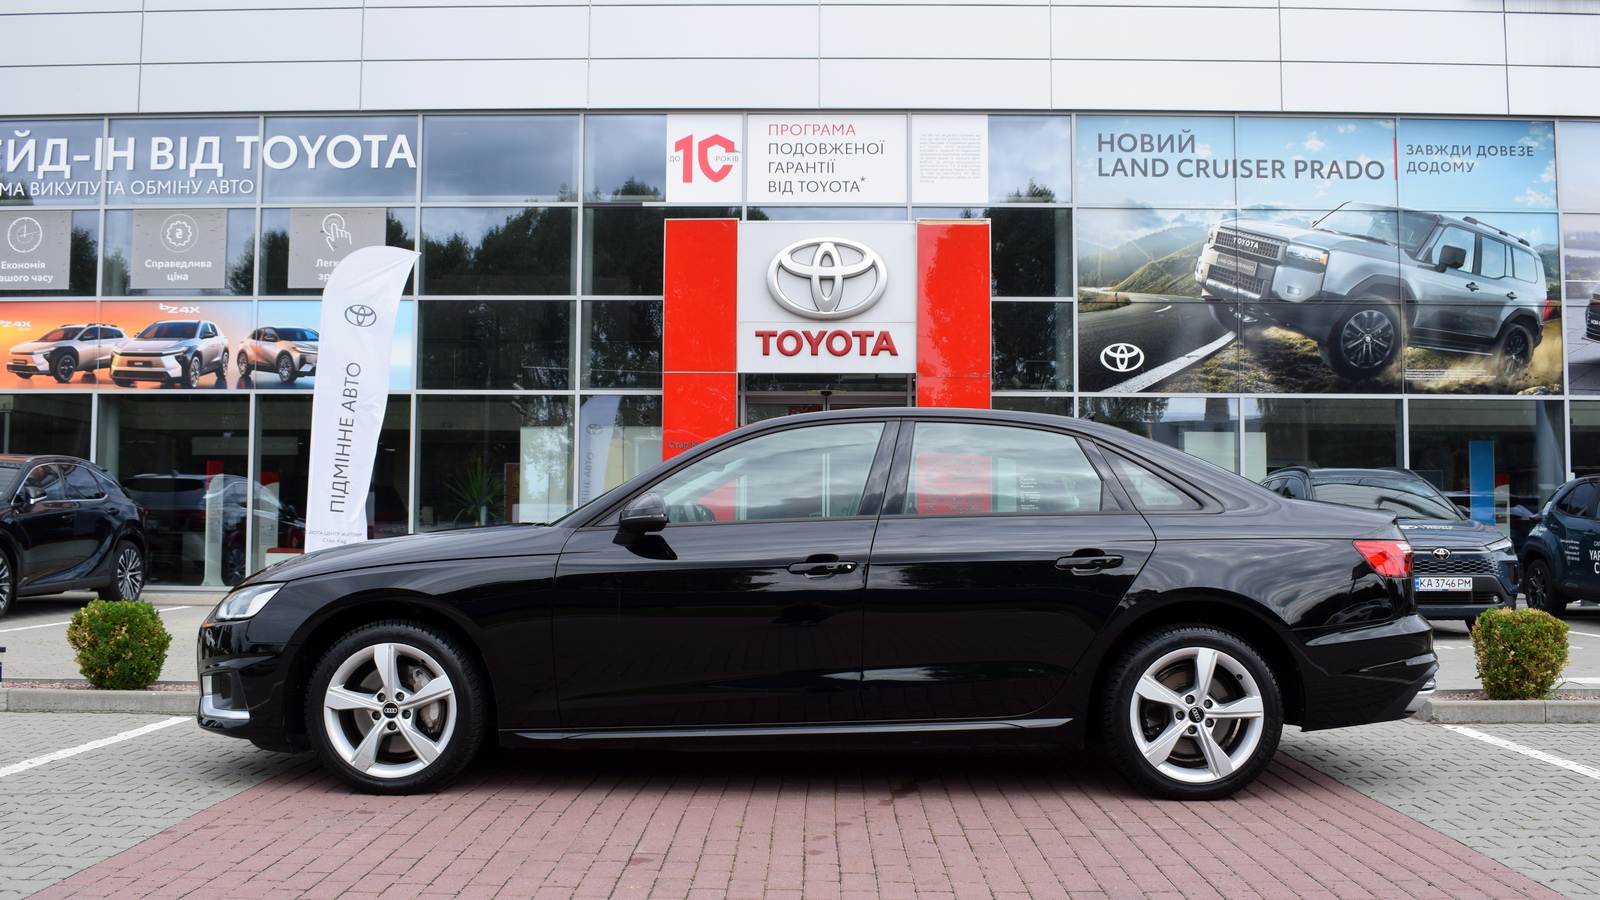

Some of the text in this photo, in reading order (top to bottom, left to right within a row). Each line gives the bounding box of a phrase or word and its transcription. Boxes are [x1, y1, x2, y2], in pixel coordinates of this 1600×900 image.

[768, 124, 856, 136] ПРОГРАМА
[768, 139, 885, 157] ПОДОВЖЕНОЇ
[1097, 129, 1196, 154] НОВИЙ
[0, 130, 417, 179] ЙД-ІН ВІД TOYOTA
[669, 155, 681, 163] ДО
[675, 133, 735, 183] 10
[1406, 144, 1534, 159] ЗАВЖДИ ДОВЕЗЕ
[768, 158, 836, 174] ГАРАНТІЇ
[1097, 157, 1385, 181] LAND CRUISER PRADO
[1406, 160, 1475, 175] ДОДОМУ
[30, 181, 102, 196] ВИКУПУ
[105, 181, 126, 196] ТА
[130, 180, 203, 195] ОБМІНУ
[206, 179, 254, 194] АВТО
[768, 180, 794, 196] ВІД
[1, 260, 46, 270] Економія
[144, 259, 212, 270] Справедлива
[31, 275, 54, 284] часу
[166, 272, 189, 283] ціна
[755, 330, 898, 357] TOYOTA
[330, 362, 361, 513] ПІДМІННЕ АВТО
[1419, 579, 1433, 588] KA
[1435, 579, 1456, 588] 3746
